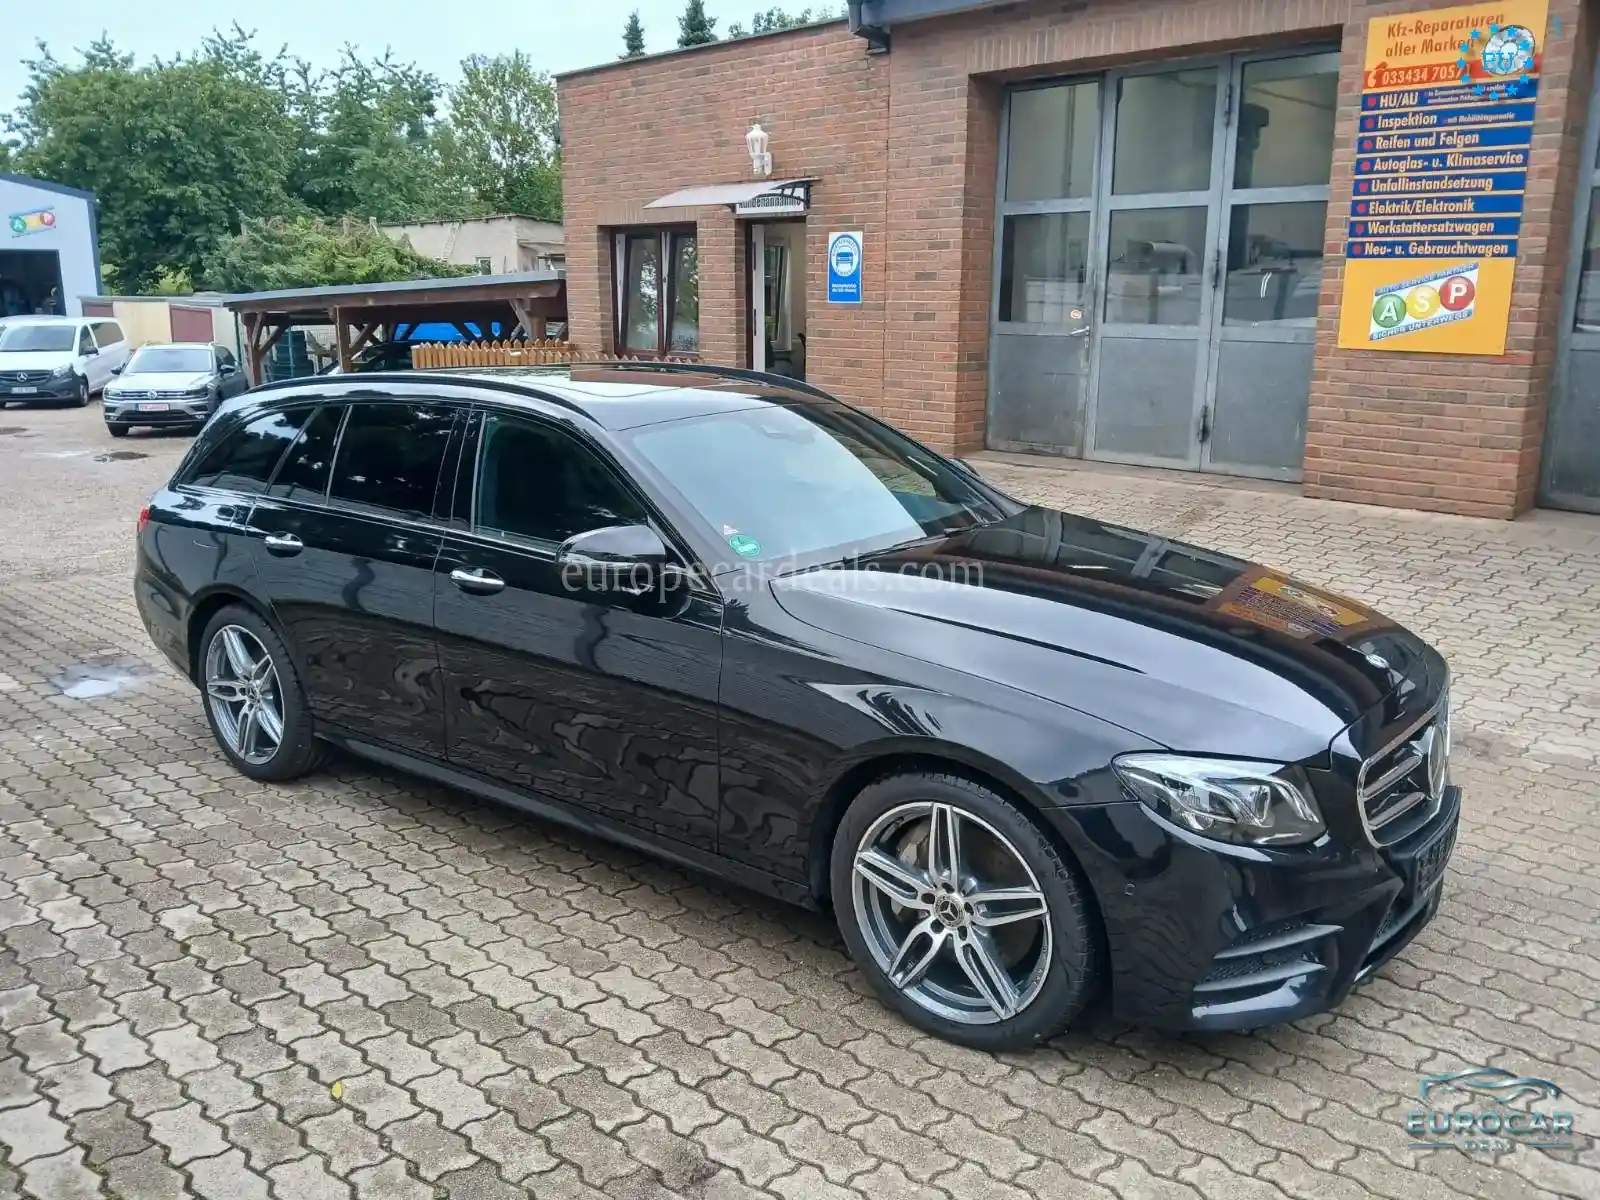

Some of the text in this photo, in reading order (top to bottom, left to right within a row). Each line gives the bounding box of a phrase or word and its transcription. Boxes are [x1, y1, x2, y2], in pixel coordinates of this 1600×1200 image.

[1387, 13, 1505, 39] Kfz-Reparaturen
[1385, 35, 1475, 58] aller Markn
[1382, 66, 1428, 85] 033434
[1379, 92, 1419, 109] HU/AU
[1378, 113, 1437, 130] Inspektion
[1375, 130, 1480, 150] Reifen und Felgen
[1373, 151, 1524, 172] Autoglas- u. Klimaservice
[1371, 176, 1493, 192] Unfallinstandsetzung
[1369, 197, 1475, 216] Elektrik/Elektronik
[1368, 220, 1494, 236] Werkstattersatzwagen
[1364, 240, 1508, 257] Neu- u. Gebrauchtwagen
